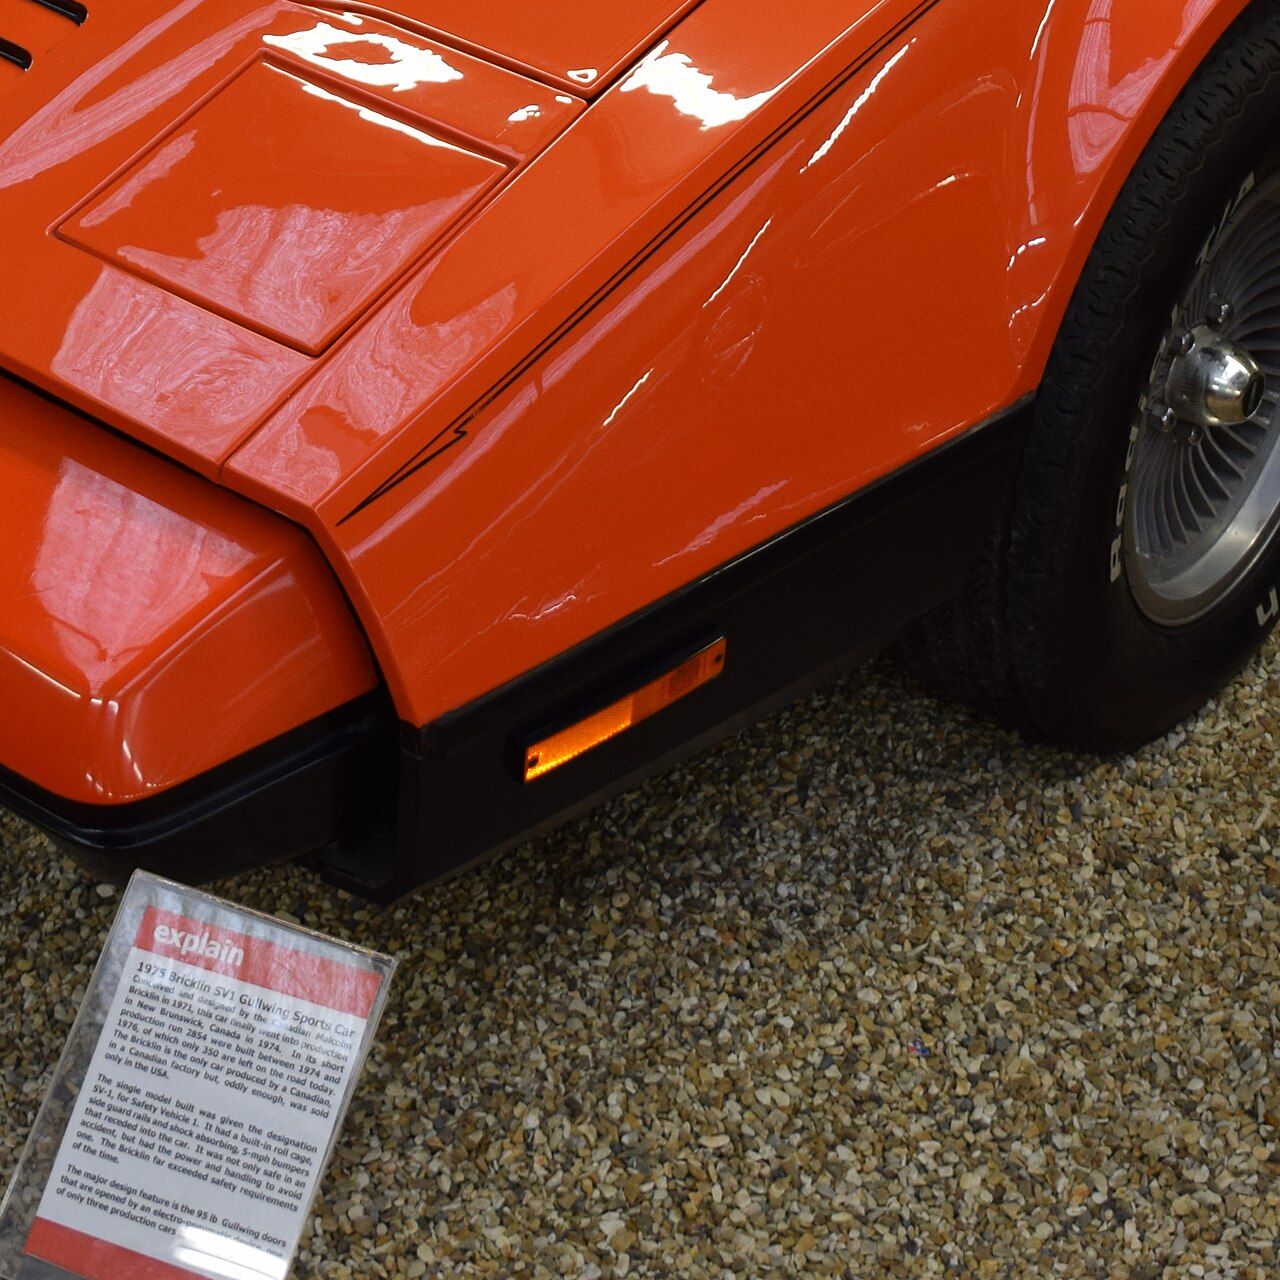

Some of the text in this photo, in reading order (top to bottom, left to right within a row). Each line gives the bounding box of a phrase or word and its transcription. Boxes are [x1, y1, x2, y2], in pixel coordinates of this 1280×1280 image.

[153, 919, 245, 968] explain
[128, 985, 159, 1001] Bricklin
[171, 998, 193, 1014] 1971,
[196, 1007, 213, 1018] this
[214, 1014, 228, 1023] car
[281, 1034, 299, 1046] into
[136, 999, 155, 1012] New
[159, 1007, 203, 1029] Brunswick,
[208, 1022, 241, 1039] Canada
[258, 1038, 281, 1053] 1974.
[291, 1048, 301, 1059] In
[305, 1054, 317, 1064] its
[321, 1060, 345, 1073] short
[168, 971, 211, 993] Bricklin
[213, 985, 235, 1000] SV1
[292, 1010, 331, 1031] Sports
[333, 1023, 355, 1038] Car
[112, 1028, 128, 1040] The
[130, 1034, 161, 1051] Bricklin
[172, 1048, 187, 1059] the
[189, 1055, 208, 1068] only
[209, 1061, 223, 1071] car
[225, 1067, 267, 1085] produced
[268, 1079, 279, 1091] by
[289, 1085, 331, 1108] Canadian,
[116, 1018, 335, 1096] 1976, of which only 350 are left on the road today.
[119, 1008, 341, 1084] production run 2854 were built between 1974 and
[128, 1046, 167, 1066] Canadian
[170, 1060, 200, 1078] factory
[203, 1070, 219, 1085] but,
[223, 1079, 247, 1094] oddly
[250, 1088, 284, 1106] enough,
[289, 1100, 307, 1111] was
[310, 1107, 329, 1118] sold
[83, 1107, 102, 1119] that
[103, 1115, 137, 1131] receded
[138, 1125, 156, 1138] into
[157, 1132, 172, 1143] the
[174, 1138, 189, 1149] car.
[205, 1149, 223, 1160] was
[225, 1156, 240, 1166] not
[242, 1161, 260, 1175] only
[262, 1168, 281, 1180] safe
[294, 1179, 306, 1188] an
[87, 1097, 310, 1176] side guard rails and shock absorbing, 5-mph bumpers
[92, 1084, 113, 1100] SV-1,
[116, 1092, 128, 1103] for
[130, 1097, 157, 1114] Safety
[159, 1106, 190, 1123] Vehicle
[214, 1125, 231, 1137] had
[240, 1133, 271, 1151] built-in
[273, 1146, 289, 1156] roll
[289, 1151, 312, 1166] cage,
[96, 1073, 317, 1153] The single model built was given the designation
[75, 1130, 298, 1212] one. The Bricklin far exceeded safety requirements
[79, 1119, 302, 1200] accident, but had the power and handling to avoid
